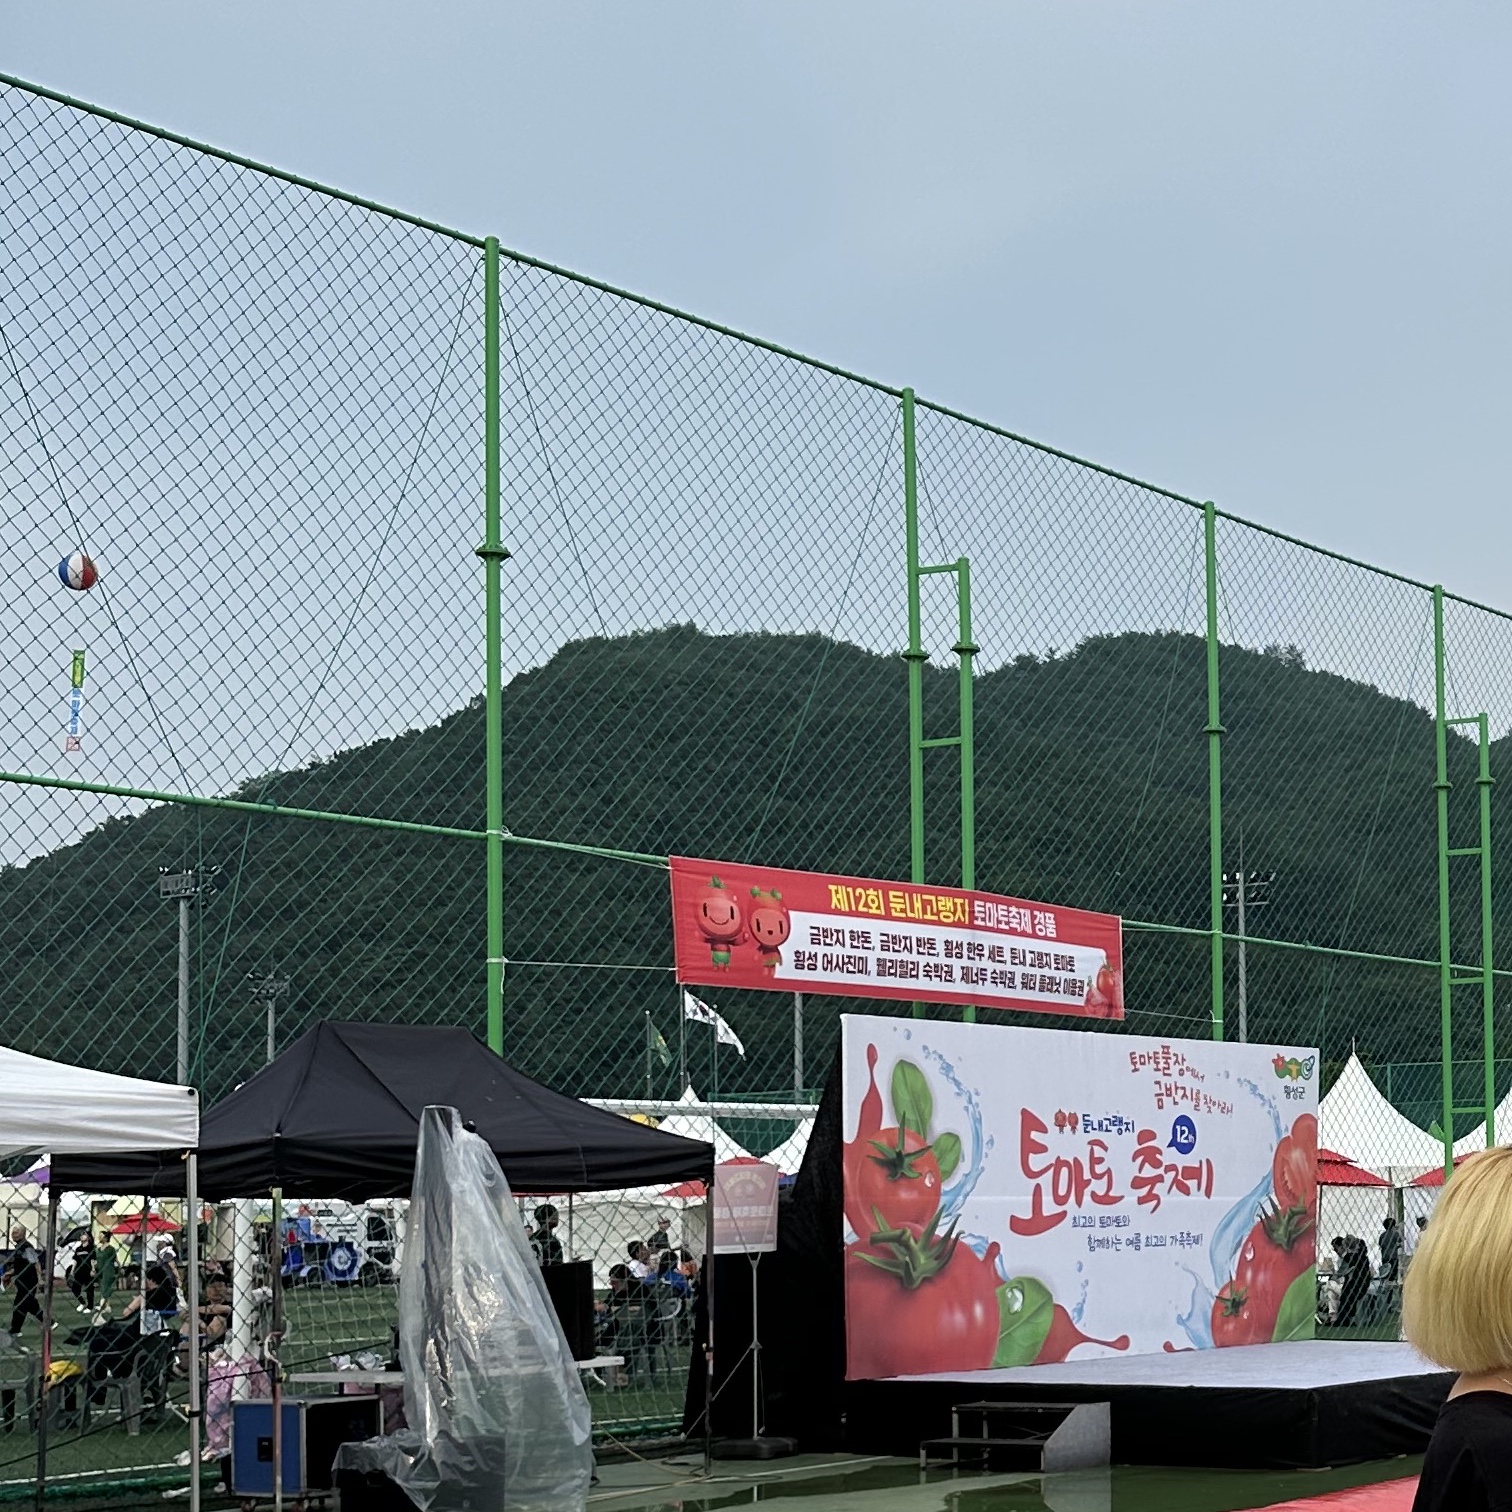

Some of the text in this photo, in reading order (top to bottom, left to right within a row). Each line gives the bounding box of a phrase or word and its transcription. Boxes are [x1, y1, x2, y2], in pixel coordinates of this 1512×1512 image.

[828, 884, 1057, 938] 제12회 둔내고랭지 토마토축제 경품
[809, 925, 1076, 973] 금반지 한돈, 금반지 반돈, 횡성 한우 세트, 둔내 고랭지 토마토
[794, 949, 818, 971] 횡성
[822, 952, 871, 976] 어사진미,
[876, 957, 920, 979] 웰리힐리
[923, 961, 957, 983] 숙박권,
[960, 965, 988, 986] 제너두
[990, 968, 1017, 990] 숙박권,
[1063, 977, 1085, 997] 이용권
[1129, 1044, 1206, 1083] 토마토풀장에서
[1154, 1080, 1201, 1112] 금반지를
[1283, 1084, 1307, 1100] 횡성군
[1082, 1113, 1136, 1136] 둔내고랭지
[1009, 1107, 1215, 1237] 토마토 축제
[1071, 1214, 1132, 1229] 최고의 토마토와
[1087, 1233, 1123, 1252] 함께하는
[1125, 1232, 1142, 1252] 여름
[1144, 1234, 1168, 1248] 최고의
